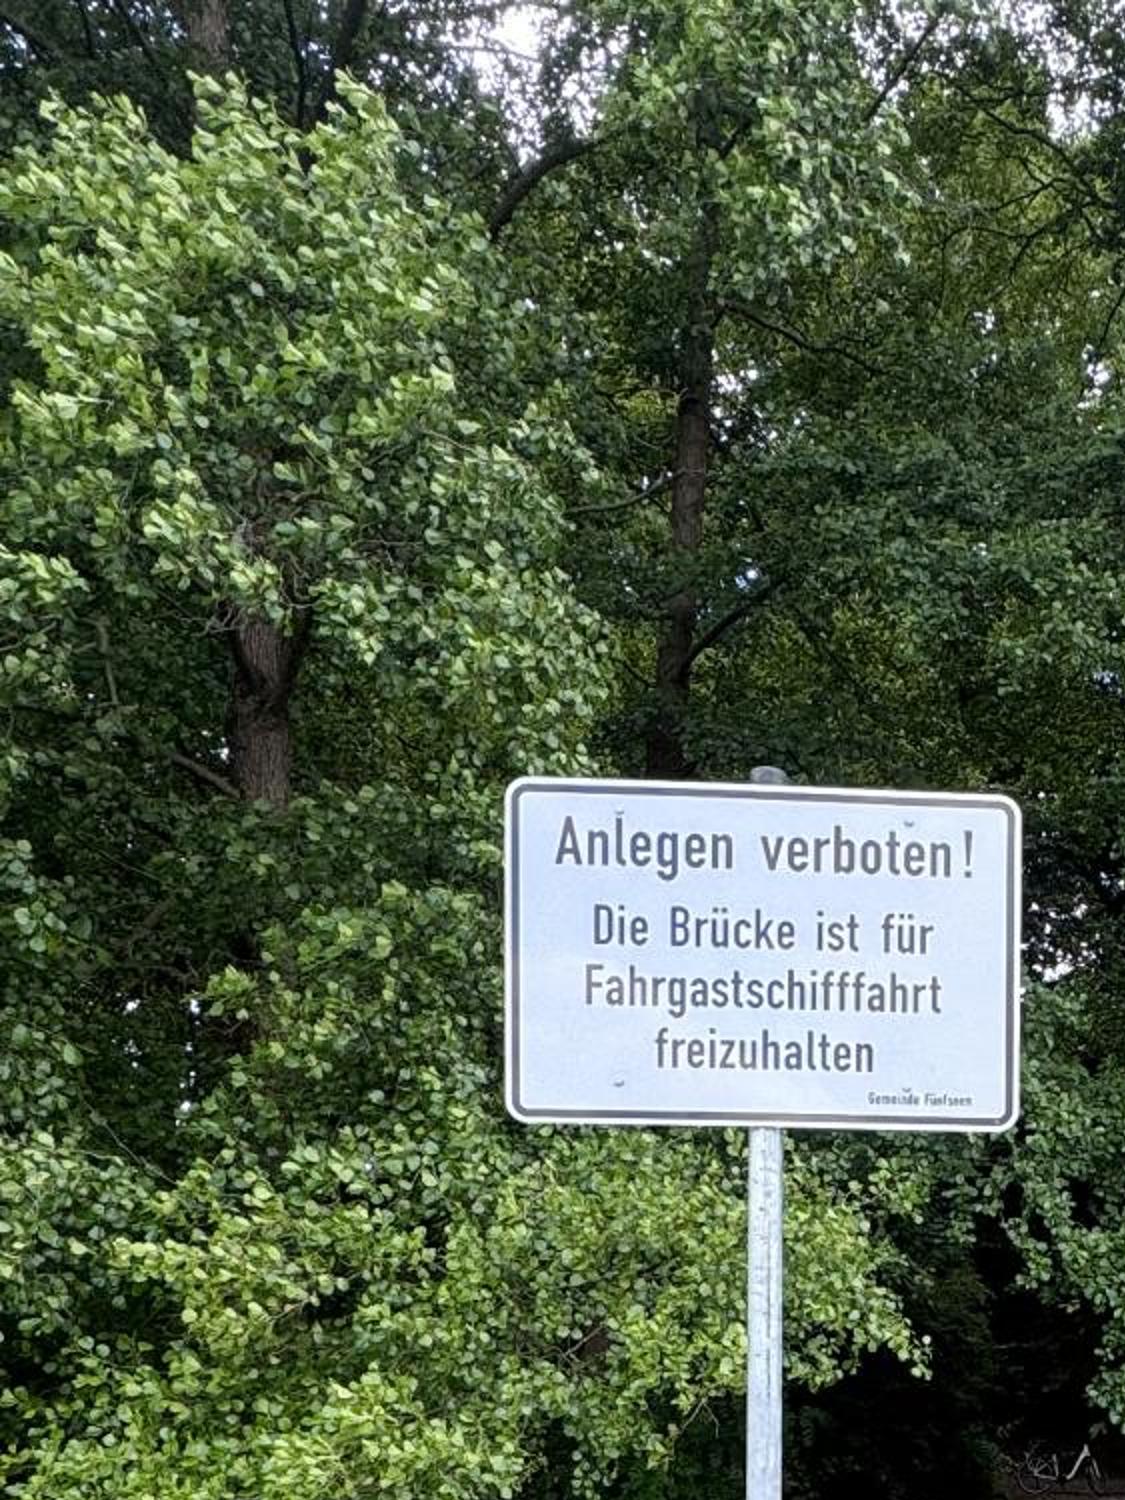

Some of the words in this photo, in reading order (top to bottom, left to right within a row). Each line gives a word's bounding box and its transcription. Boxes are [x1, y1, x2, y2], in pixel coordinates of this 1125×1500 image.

[556, 815, 734, 881] Anlegen
[761, 824, 974, 879] verboten!
[593, 903, 649, 947] Die
[670, 905, 795, 951] Brücke
[816, 910, 861, 954] ist
[882, 913, 935, 955] für
[585, 964, 942, 1020] Fahrgastschifffahrt
[655, 1028, 874, 1074] freizuhalten
[867, 1091, 920, 1106] Gemeinde
